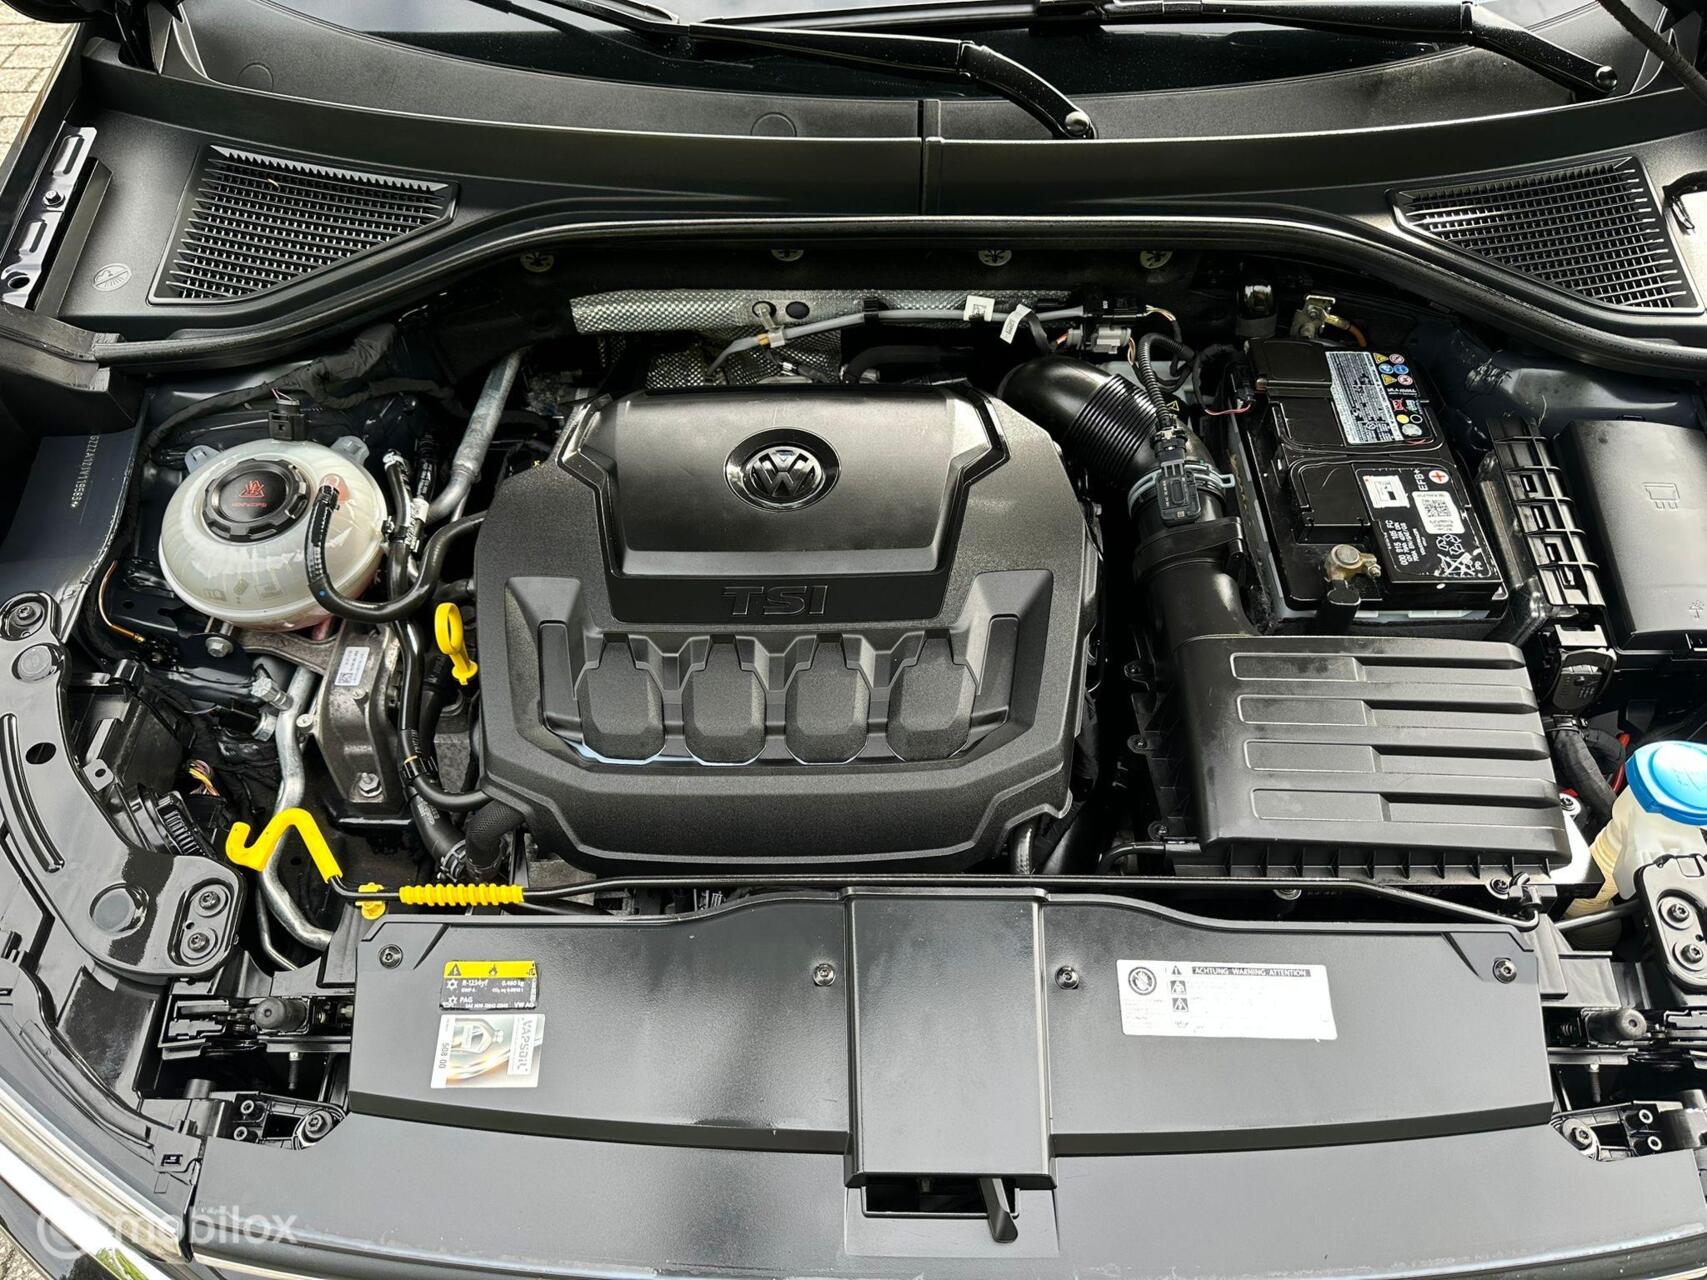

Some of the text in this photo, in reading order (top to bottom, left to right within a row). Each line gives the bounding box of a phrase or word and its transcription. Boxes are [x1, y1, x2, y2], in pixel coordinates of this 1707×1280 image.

[722, 584, 829, 616] TSI
[1194, 967, 1307, 977] ACHTUNG WARNING ATTENTION
